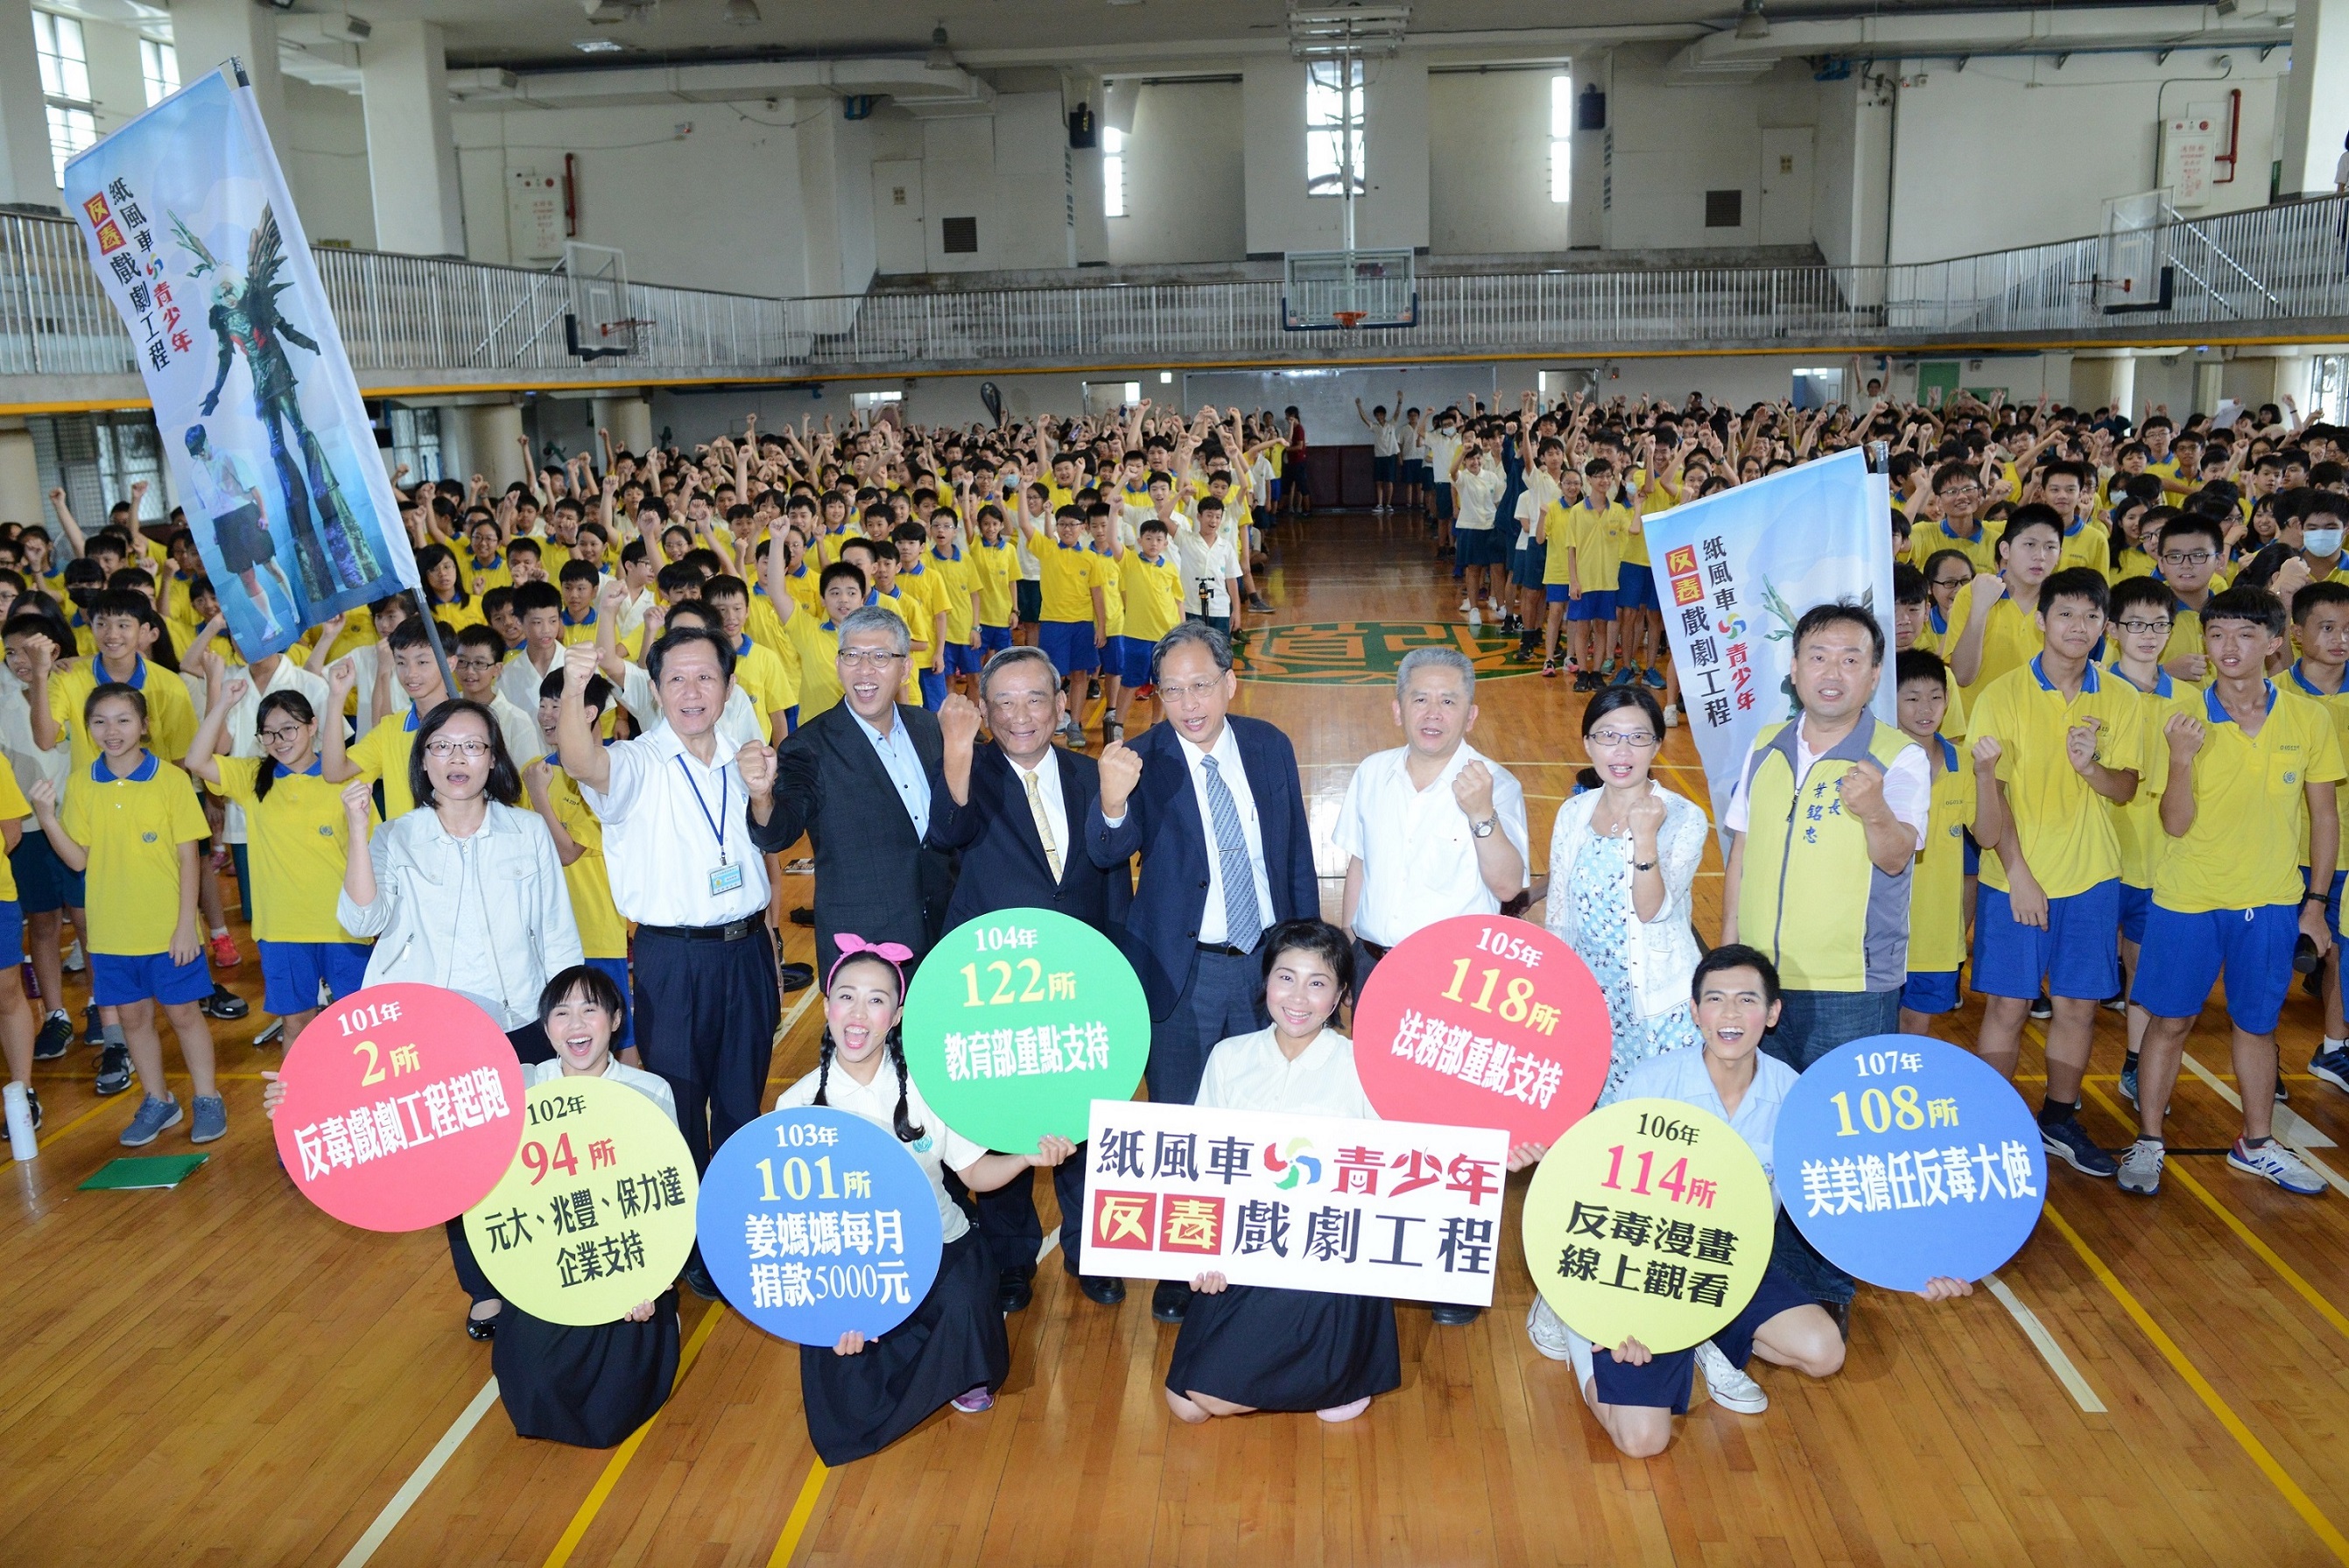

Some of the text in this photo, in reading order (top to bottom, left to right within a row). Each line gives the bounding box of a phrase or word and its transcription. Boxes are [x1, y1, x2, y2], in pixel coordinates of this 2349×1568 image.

[109, 177, 193, 353] 紙風車 青少年
[1702, 535, 1756, 711] 紙風車 青少年
[1803, 781, 1828, 844] 葉銘忠
[974, 925, 1038, 952] 104年
[1475, 926, 1544, 970] 105年
[960, 957, 1077, 1009] 122所
[1440, 957, 1563, 1037] 118所
[337, 1001, 403, 1037] 101年
[944, 1021, 1110, 1083] 教育部重點支持
[1390, 1007, 1565, 1111] 法務部重點支持
[1854, 1050, 1924, 1079] 107年
[293, 1065, 510, 1183] 反毒戲劇工程起跑
[526, 1093, 587, 1126] 102年
[775, 1122, 839, 1148] 103年
[1635, 1111, 1701, 1147] 106年
[1829, 1084, 1959, 1138] 108所
[756, 1155, 871, 1202] 101所
[1096, 1127, 1499, 1206] 紙風車 青少年
[1600, 1143, 1718, 1210] 114所
[1800, 1138, 2038, 1220] 美美擔任反毒大使
[484, 1165, 686, 1254] 元大、兆豐、保力達
[744, 1208, 904, 1261] 姜媽媽每月
[1565, 1199, 1740, 1267] 反毒漫畫
[555, 1229, 646, 1290] 企業支持
[749, 1260, 911, 1309] 捐款5000元
[1557, 1243, 1730, 1309] 線上觀看
